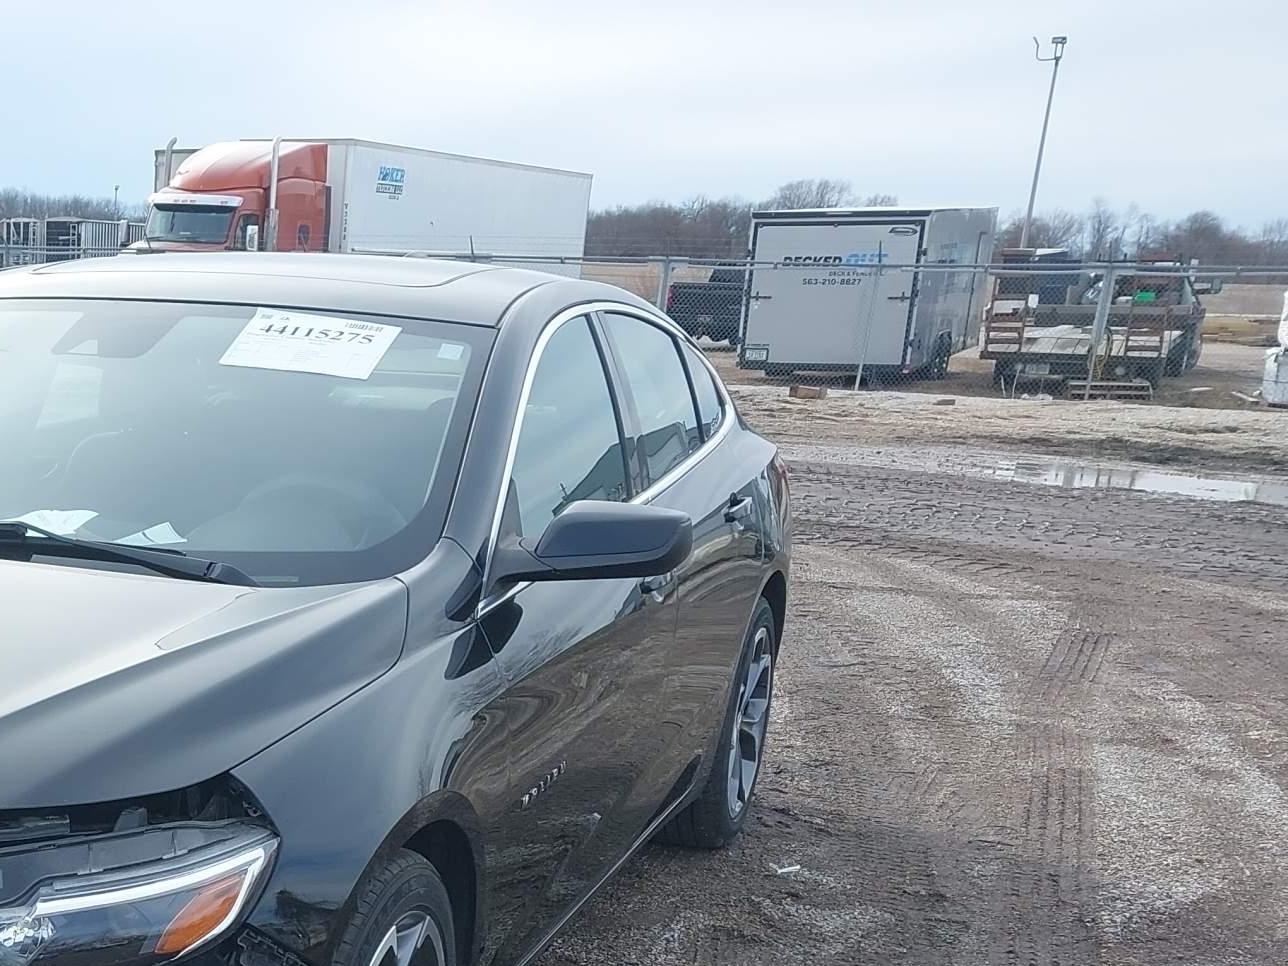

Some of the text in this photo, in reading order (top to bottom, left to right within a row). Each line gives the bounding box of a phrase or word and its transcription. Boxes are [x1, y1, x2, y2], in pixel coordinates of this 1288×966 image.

[782, 256, 843, 268] DECKED
[802, 278, 862, 286] 563-210-8827
[260, 322, 376, 345] 44115275
